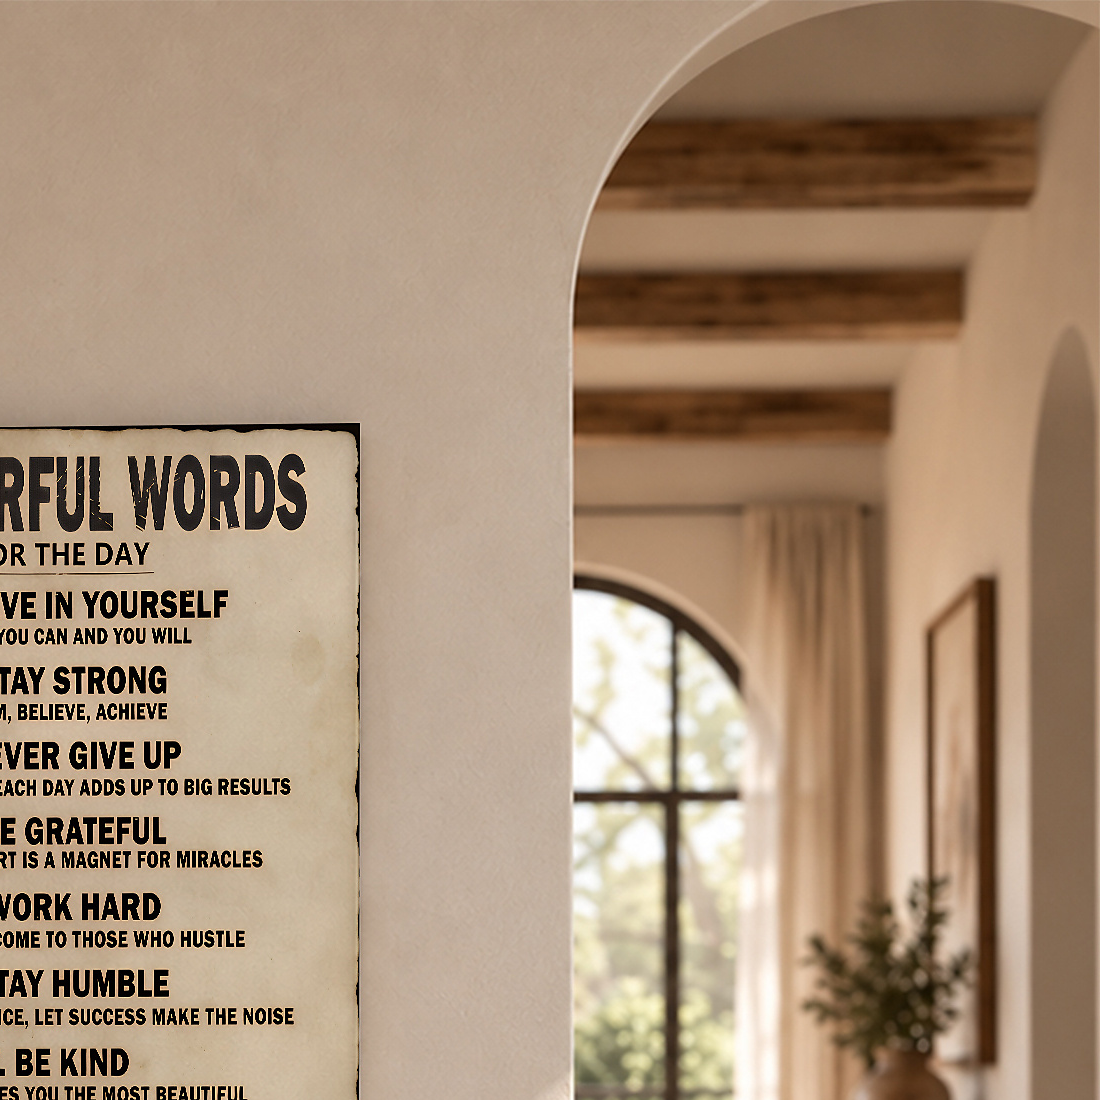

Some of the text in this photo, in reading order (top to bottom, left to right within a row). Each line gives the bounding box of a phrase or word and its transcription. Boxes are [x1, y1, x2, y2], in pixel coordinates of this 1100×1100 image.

[127, 453, 308, 532] WORDS
[34, 542, 86, 566] THE
[95, 542, 150, 566] DAY
[45, 591, 73, 620] IN
[81, 589, 229, 620] YOURSELF
[33, 627, 68, 646] CAN
[72, 627, 109, 645] AND
[112, 627, 147, 645] YOU
[151, 627, 193, 645] WILL
[52, 665, 167, 695] STRONG
[17, 703, 91, 725] BELIEVE,
[95, 702, 168, 721] ACHIEVE
[68, 741, 135, 770] GIVE
[143, 740, 182, 770] UP
[42, 778, 75, 797] DAY
[79, 778, 126, 797] ADDS
[130, 778, 154, 796] UP
[157, 778, 179, 796] TO
[183, 778, 213, 796] BIG
[217, 777, 292, 796] RESULTS
[24, 816, 167, 846] GRATEFUL
[22, 850, 39, 869] IS
[43, 850, 56, 869] A
[61, 850, 132, 869] MAGNET
[137, 850, 171, 869] FOR
[176, 849, 264, 869] MIRACLES
[81, 892, 162, 921] HARD
[45, 930, 68, 949] TO
[71, 930, 129, 949] THOSE
[132, 930, 175, 948] WHO
[180, 929, 246, 948] HUSTLE
[52, 969, 170, 998] HUMBLE
[34, 1008, 64, 1026] LET
[68, 1007, 147, 1026] SUCCESS
[152, 1007, 200, 1026] MAKE
[204, 1007, 238, 1026] THE
[242, 1007, 295, 1026] NOISE
[15, 1048, 51, 1077] BE
[60, 1048, 130, 1077] KIND
